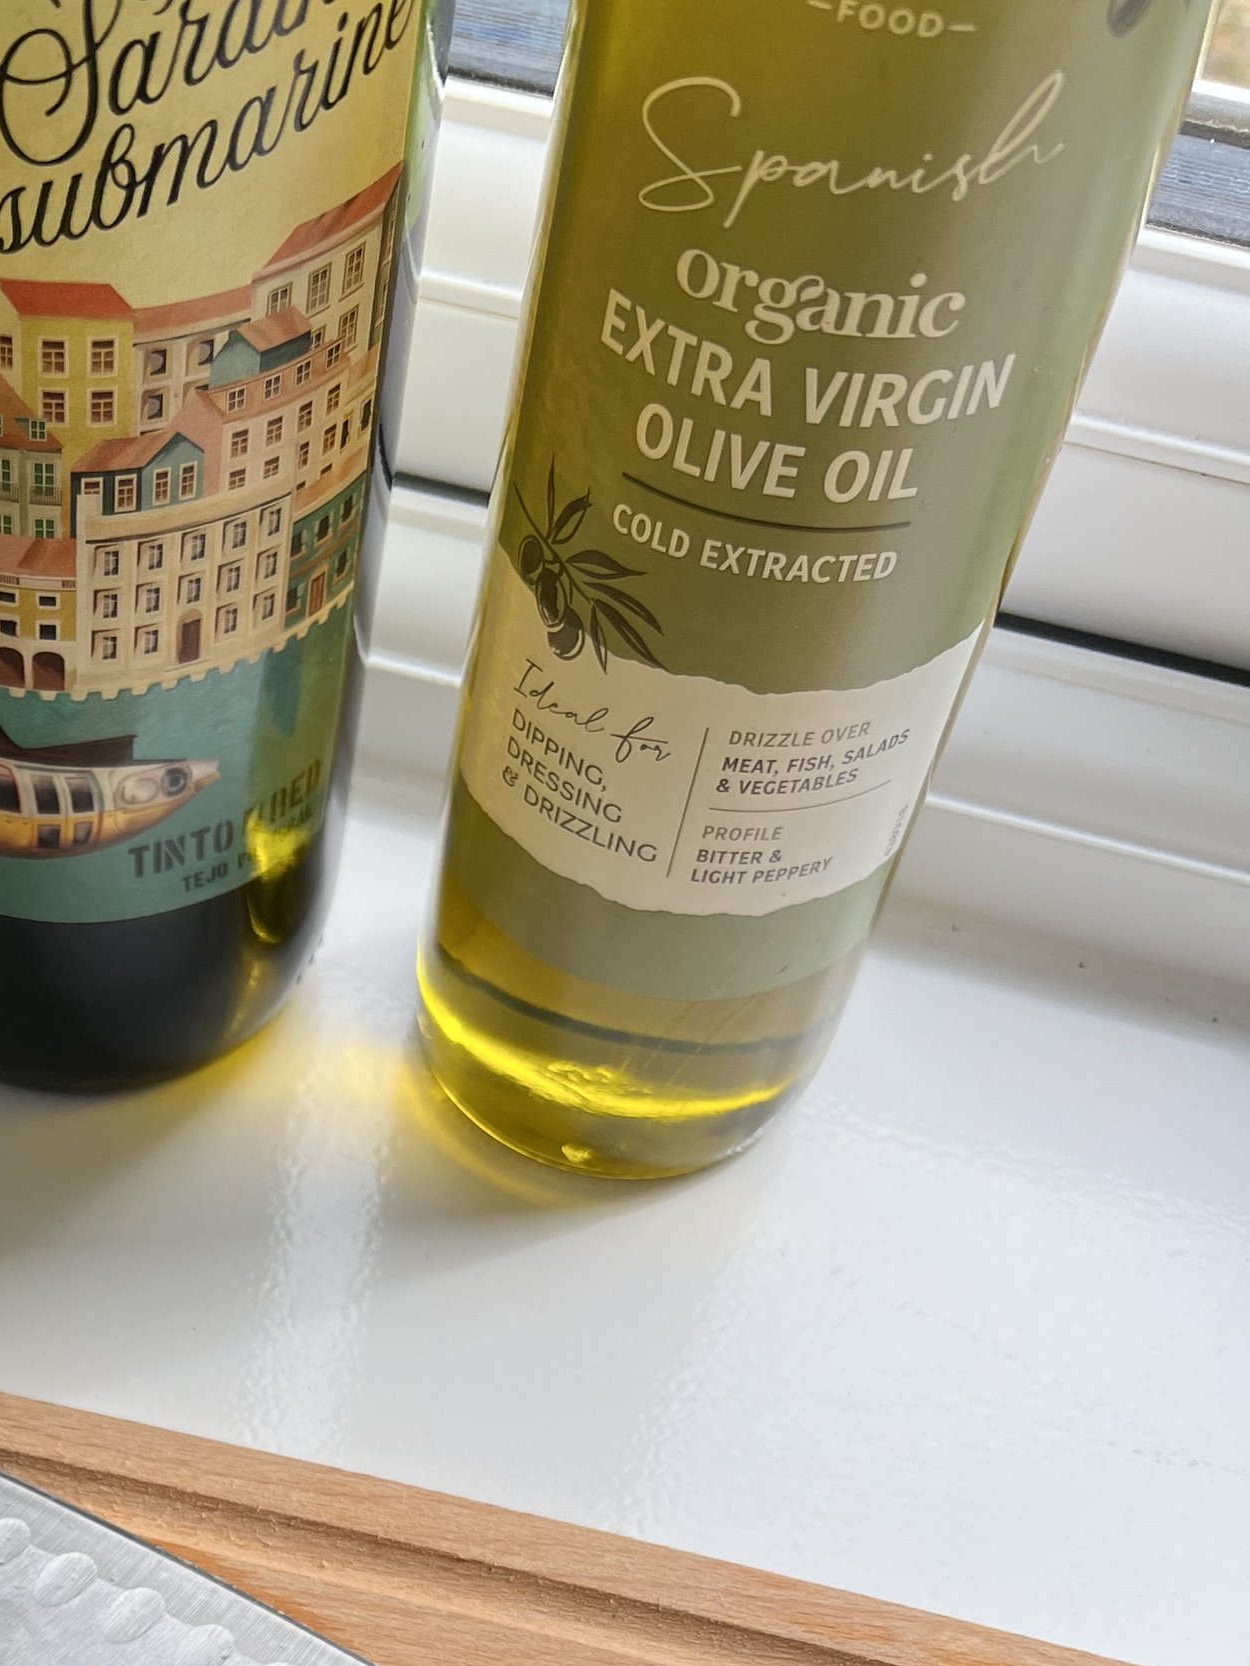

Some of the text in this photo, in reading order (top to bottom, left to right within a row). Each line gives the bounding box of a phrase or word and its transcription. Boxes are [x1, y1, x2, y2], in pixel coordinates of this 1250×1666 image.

[638, 70, 1066, 229] Spanish
[676, 248, 967, 345] organic
[600, 288, 1017, 428] EXTRA VIRGIN
[635, 403, 920, 504] OLIVE OIL
[612, 503, 899, 584] COLD EXTRACTED
[512, 707, 607, 793] DIPPING,
[513, 658, 672, 763] Ideal for
[728, 720, 872, 748] DRIZZLE OVER
[506, 735, 623, 824] DRESSING
[716, 767, 860, 796] & VEGETABLES
[721, 728, 911, 778] MEAT, FISH, SALADS
[128, 819, 233, 879] TINTO
[502, 765, 658, 862] & DRIZZLING
[701, 825, 784, 842] PROFILE
[182, 861, 228, 892] TEJO
[690, 855, 834, 885] LIGHT PEPPERY
[695, 848, 783, 865] BITTER &
